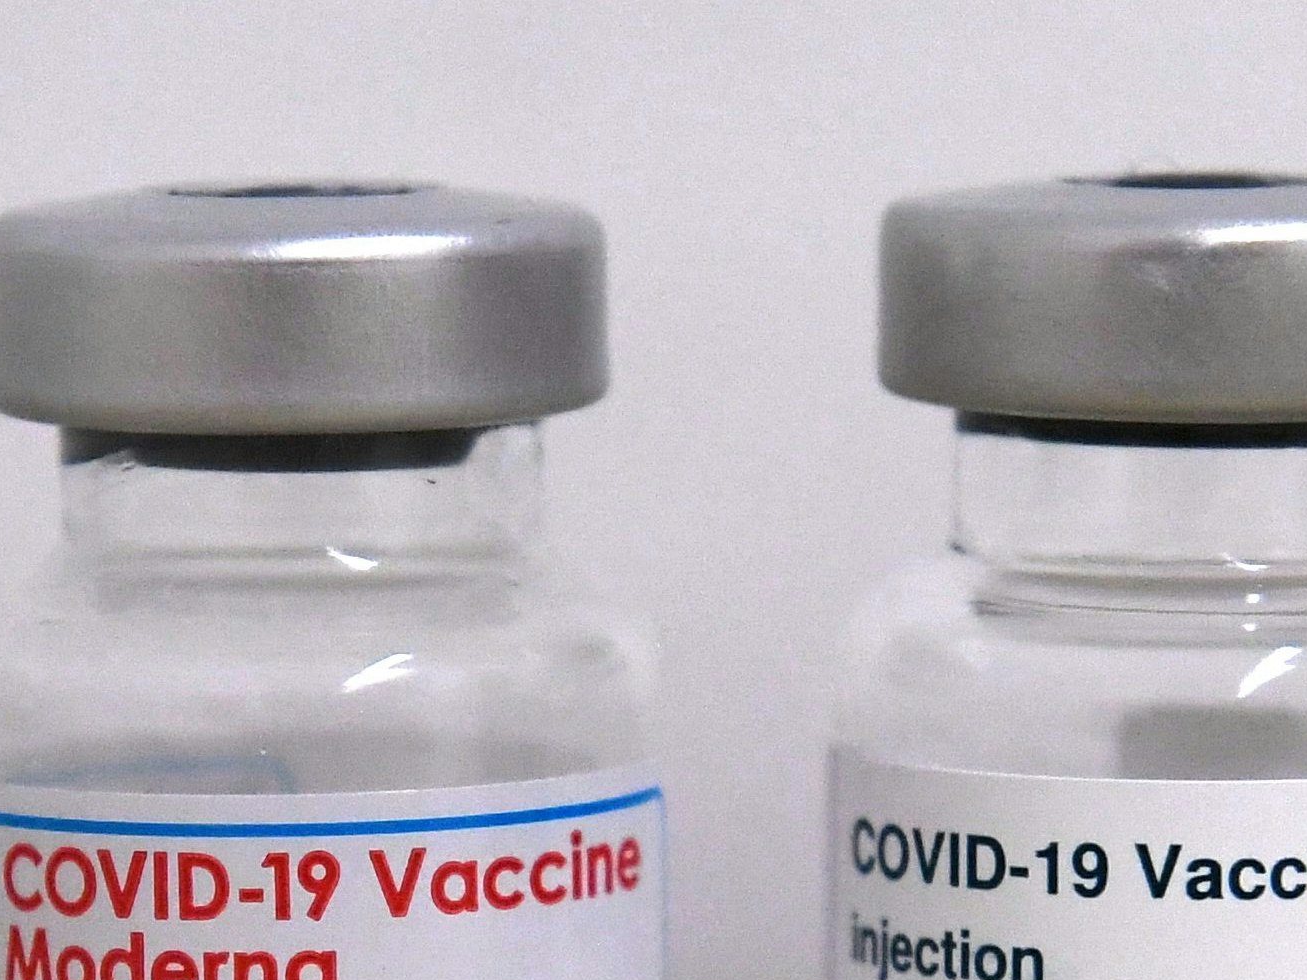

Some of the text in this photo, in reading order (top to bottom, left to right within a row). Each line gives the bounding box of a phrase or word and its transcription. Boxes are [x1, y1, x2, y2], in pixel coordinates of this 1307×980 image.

[3, 830, 642, 921] COVID-19 Vaccine
[852, 817, 1109, 899] COVID-19
